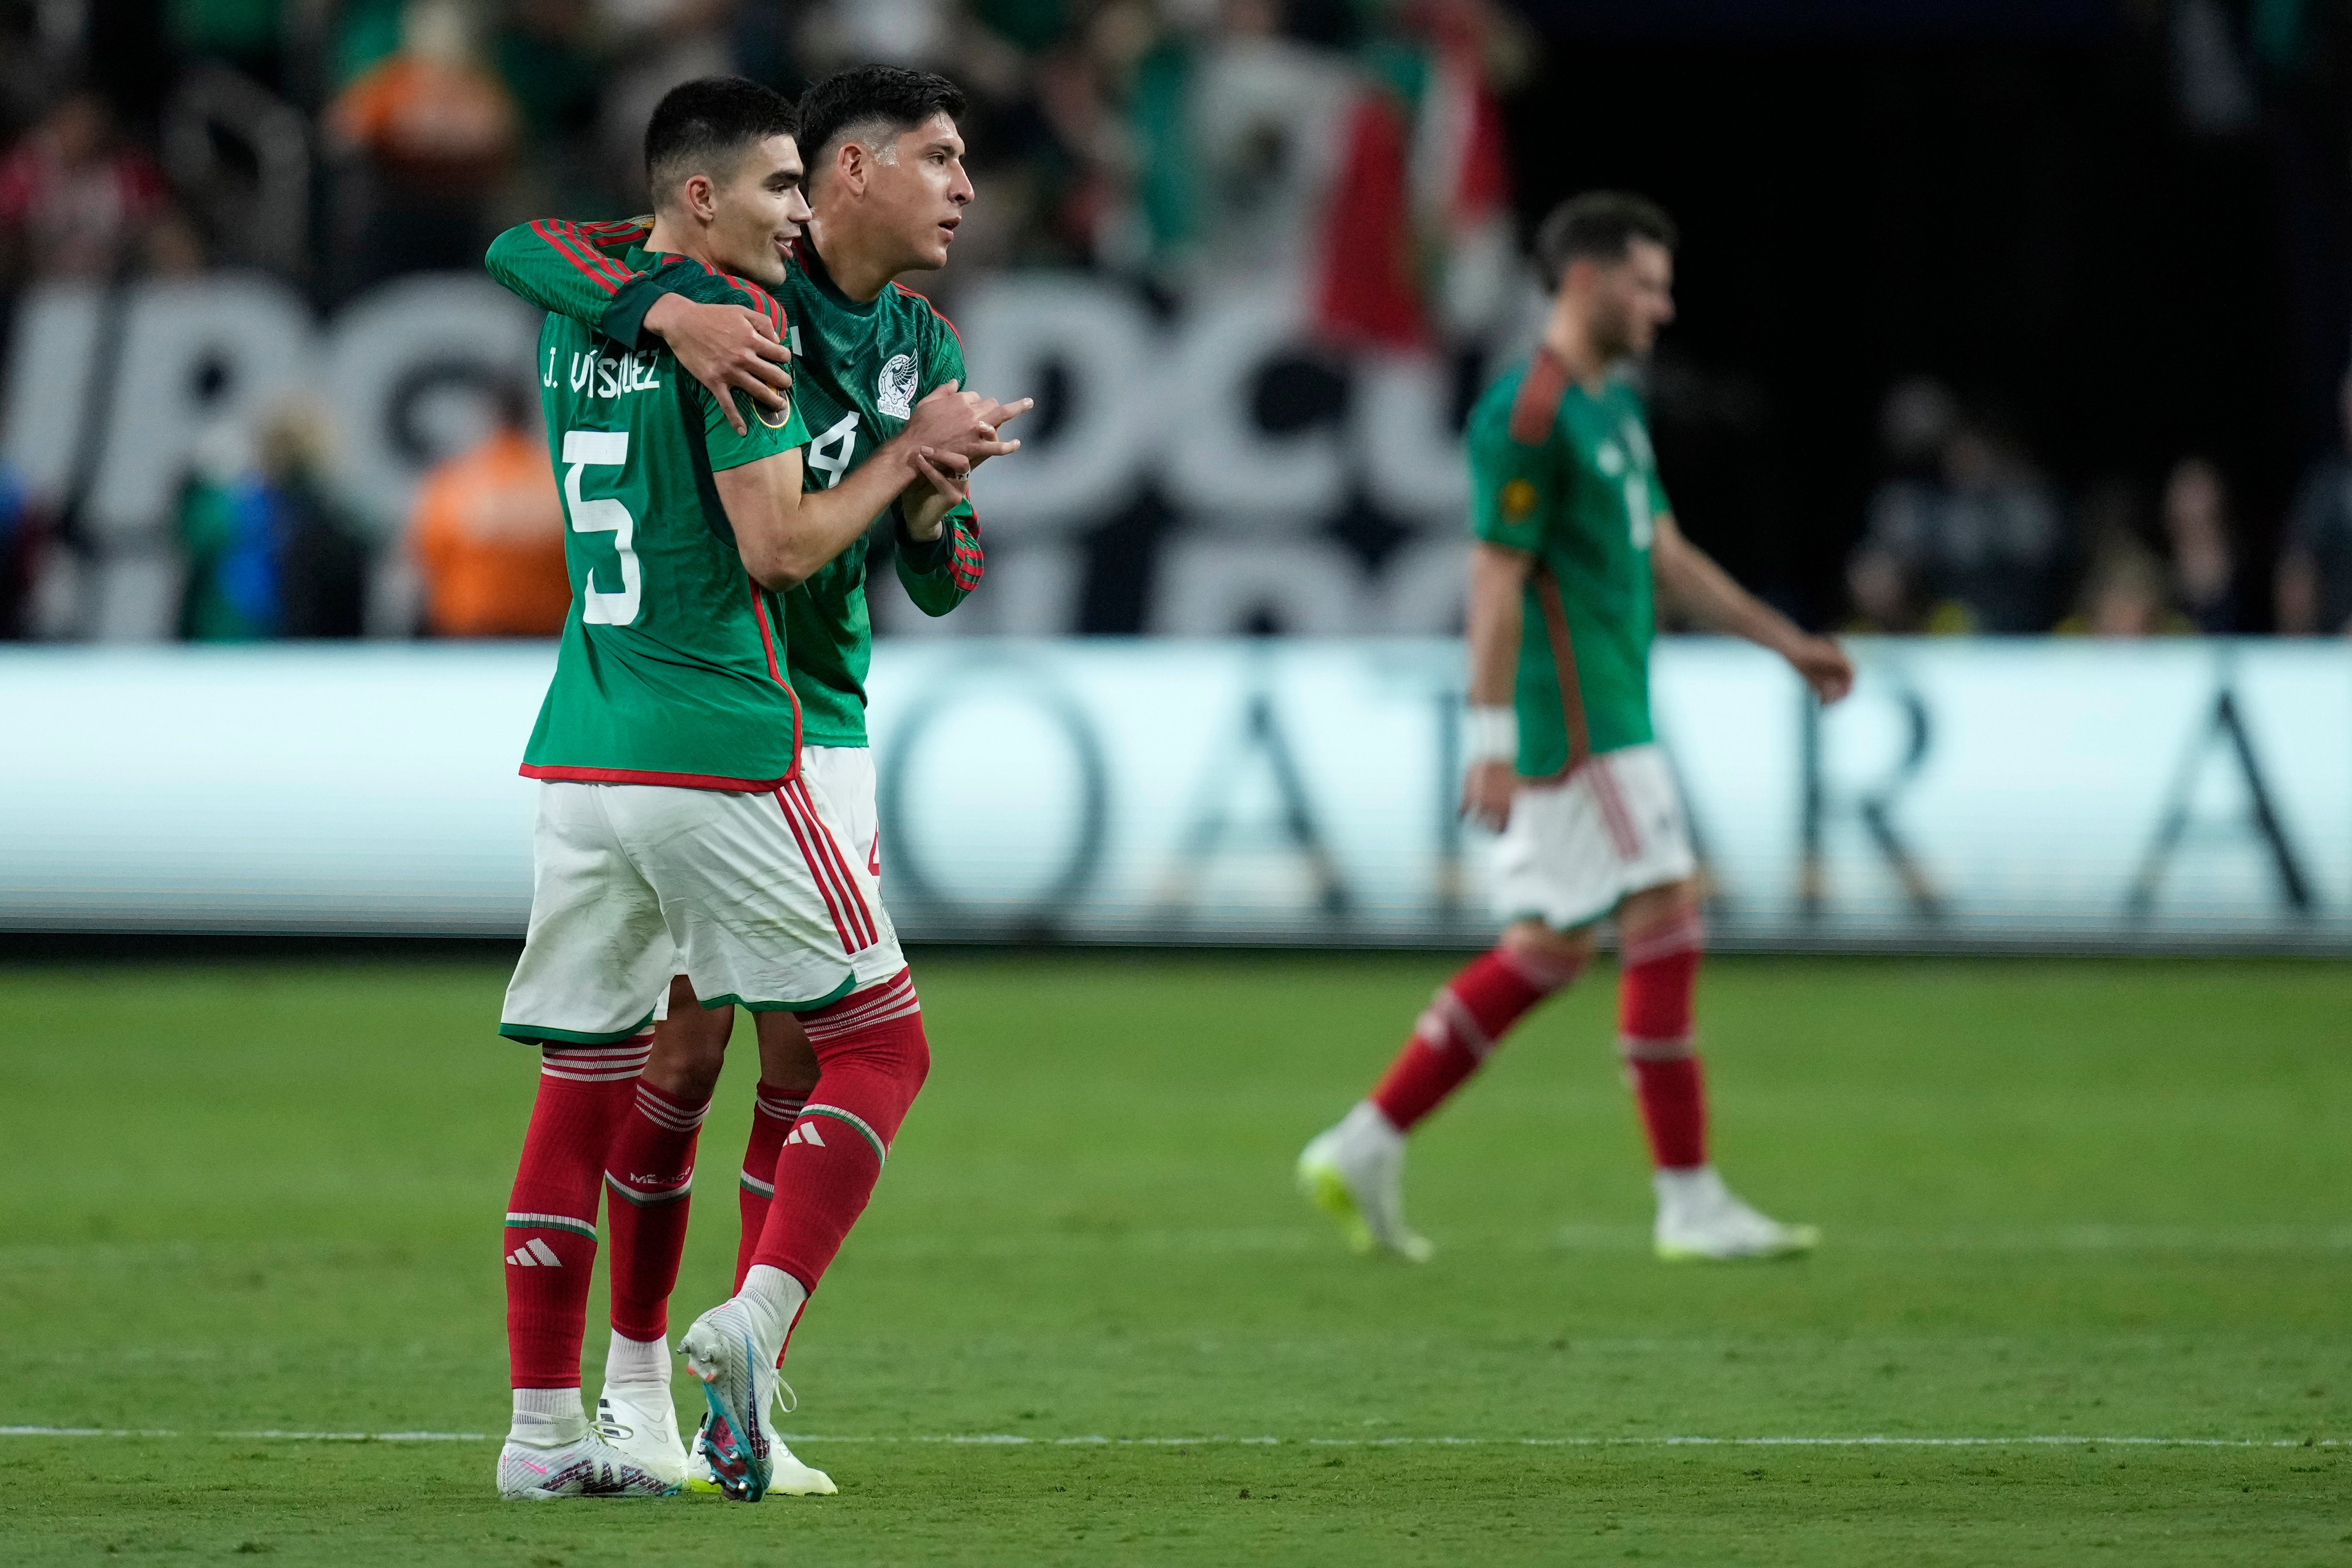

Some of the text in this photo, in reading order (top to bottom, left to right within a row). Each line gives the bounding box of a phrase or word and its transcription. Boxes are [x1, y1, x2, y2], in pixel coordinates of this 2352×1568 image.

[544, 347, 558, 388] J.
[879, 401, 909, 418] MÉXICO
[808, 410, 860, 489] 4
[562, 430, 641, 626] 5
[881, 645, 1955, 938] QATR
